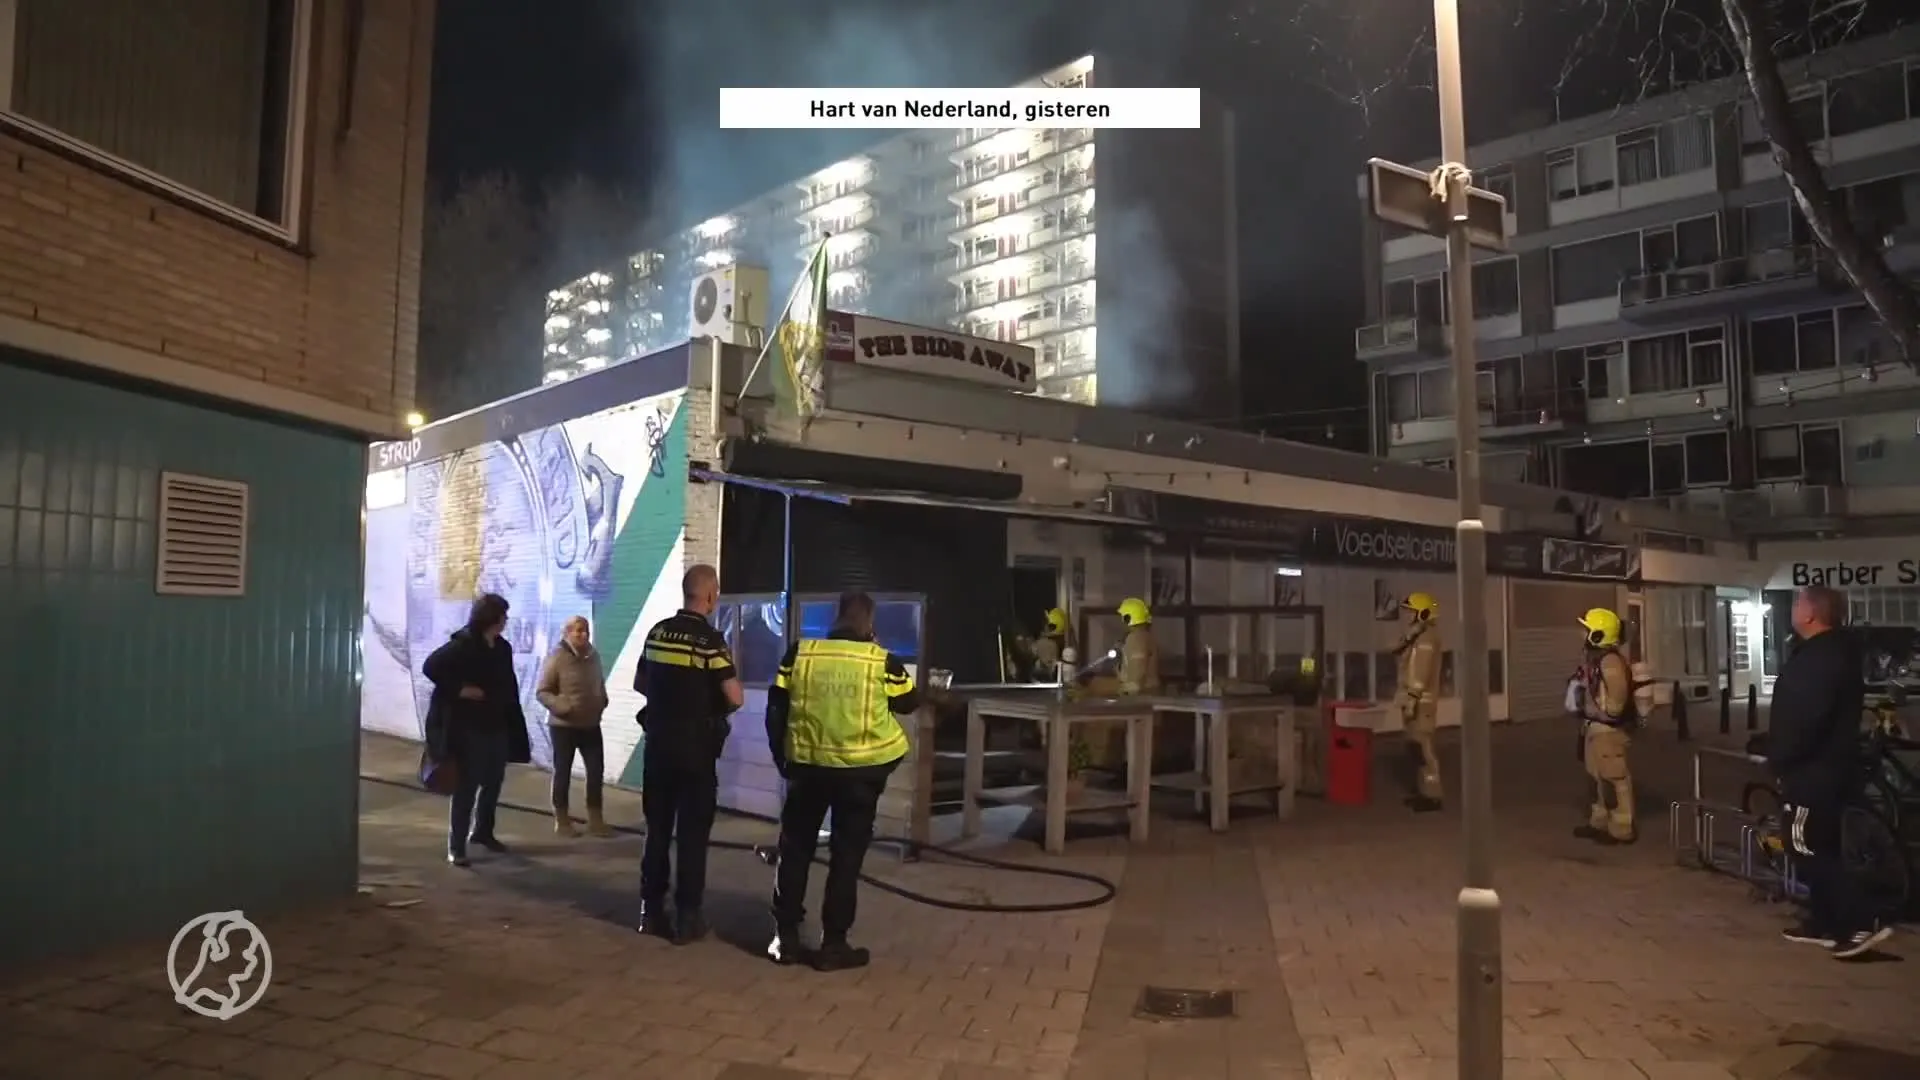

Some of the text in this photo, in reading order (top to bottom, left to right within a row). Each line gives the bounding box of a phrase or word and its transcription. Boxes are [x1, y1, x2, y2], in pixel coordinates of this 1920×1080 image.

[859, 336, 907, 358] THE
[912, 335, 965, 361] HIDE
[971, 347, 1031, 383] AWAY
[1793, 560, 1920, 586] Barber S
